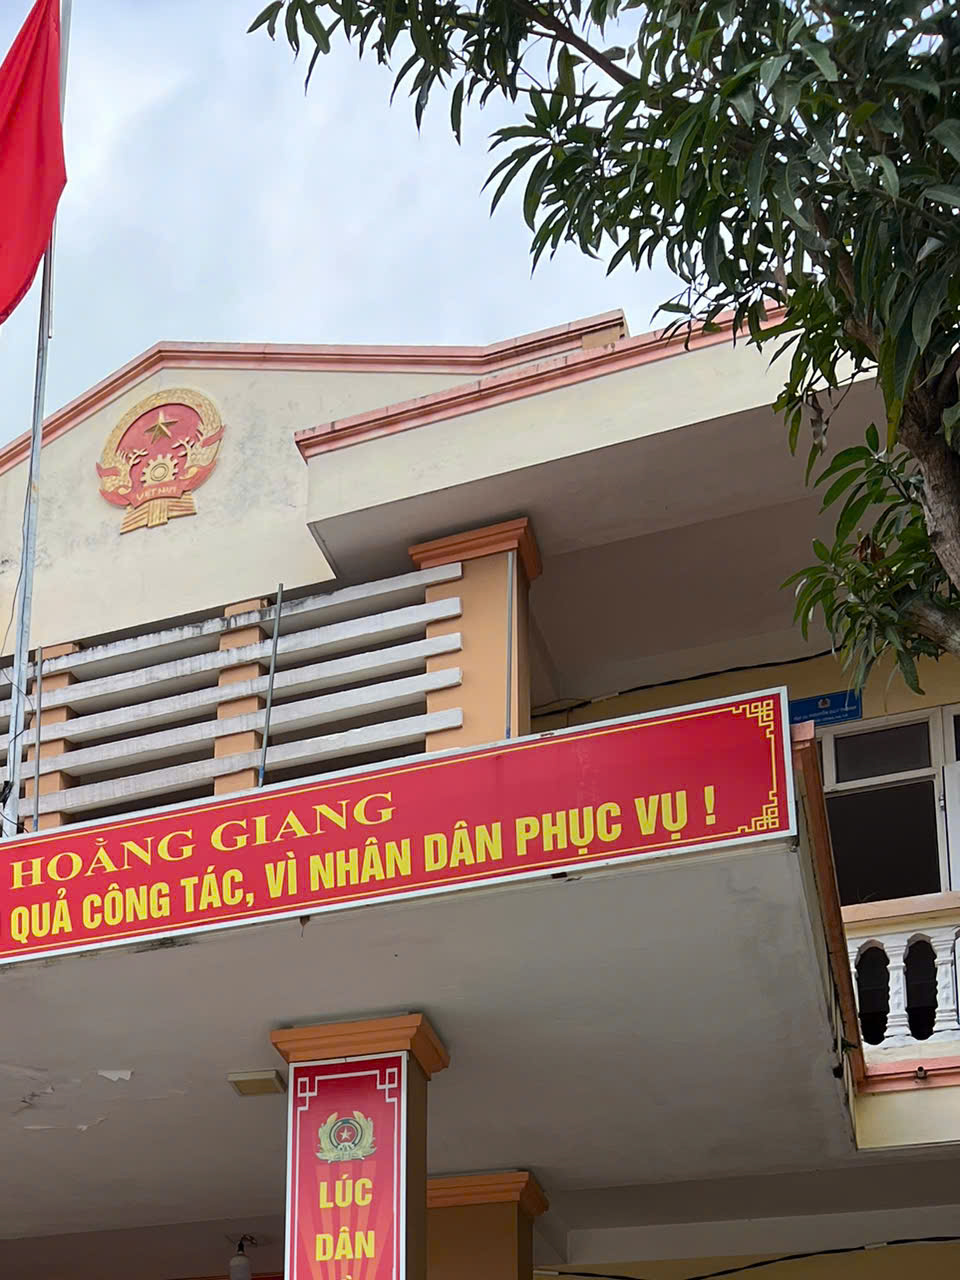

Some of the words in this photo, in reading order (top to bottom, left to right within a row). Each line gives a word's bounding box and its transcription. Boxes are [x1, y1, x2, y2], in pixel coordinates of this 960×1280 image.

[10, 829, 195, 889] HOẰNG
[210, 792, 396, 851] GIANG
[11, 888, 72, 944] QUẢ
[83, 882, 170, 929] CÔNG
[180, 866, 254, 912] TÁC,
[265, 851, 296, 898] VÌ
[310, 837, 411, 891] NHÂN
[424, 821, 502, 872] DÂN
[516, 803, 621, 856] PHỤC
[635, 792, 687, 840] VỤ
[704, 786, 715, 824] !
[320, 1174, 372, 1208] LÚC
[316, 1226, 375, 1261] DÂN
